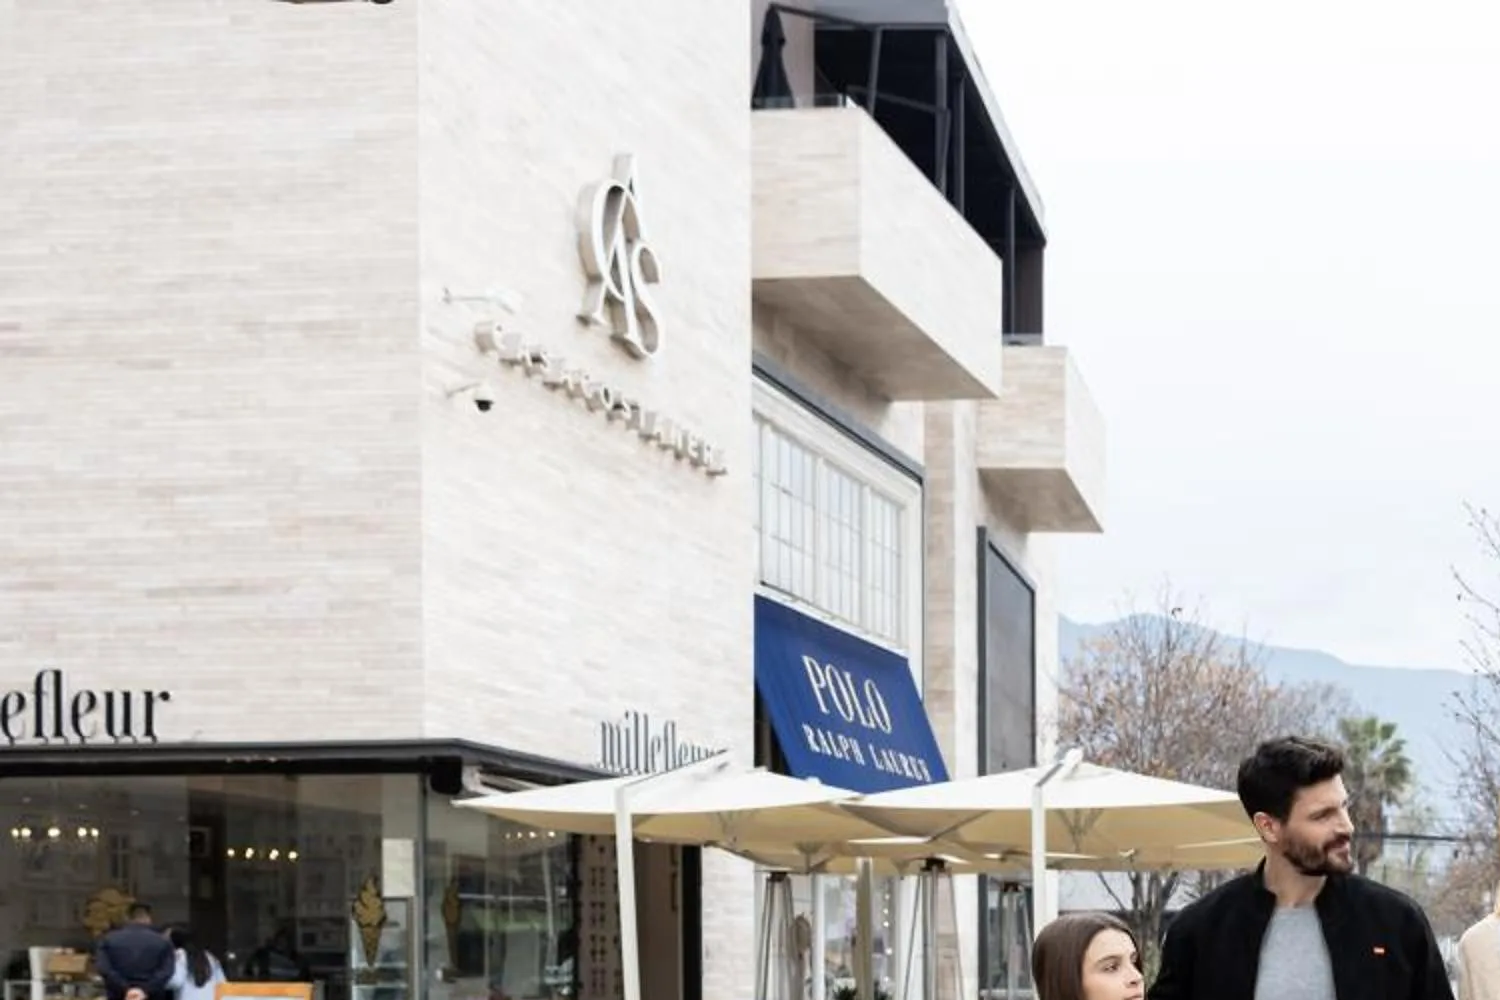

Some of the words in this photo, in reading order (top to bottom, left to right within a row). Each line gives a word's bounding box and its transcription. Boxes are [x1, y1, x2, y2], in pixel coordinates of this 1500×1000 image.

[0, 668, 171, 738] efleur
[802, 655, 892, 734] POLO
[802, 722, 866, 767] RALPH
[867, 743, 932, 783] LAUREN
